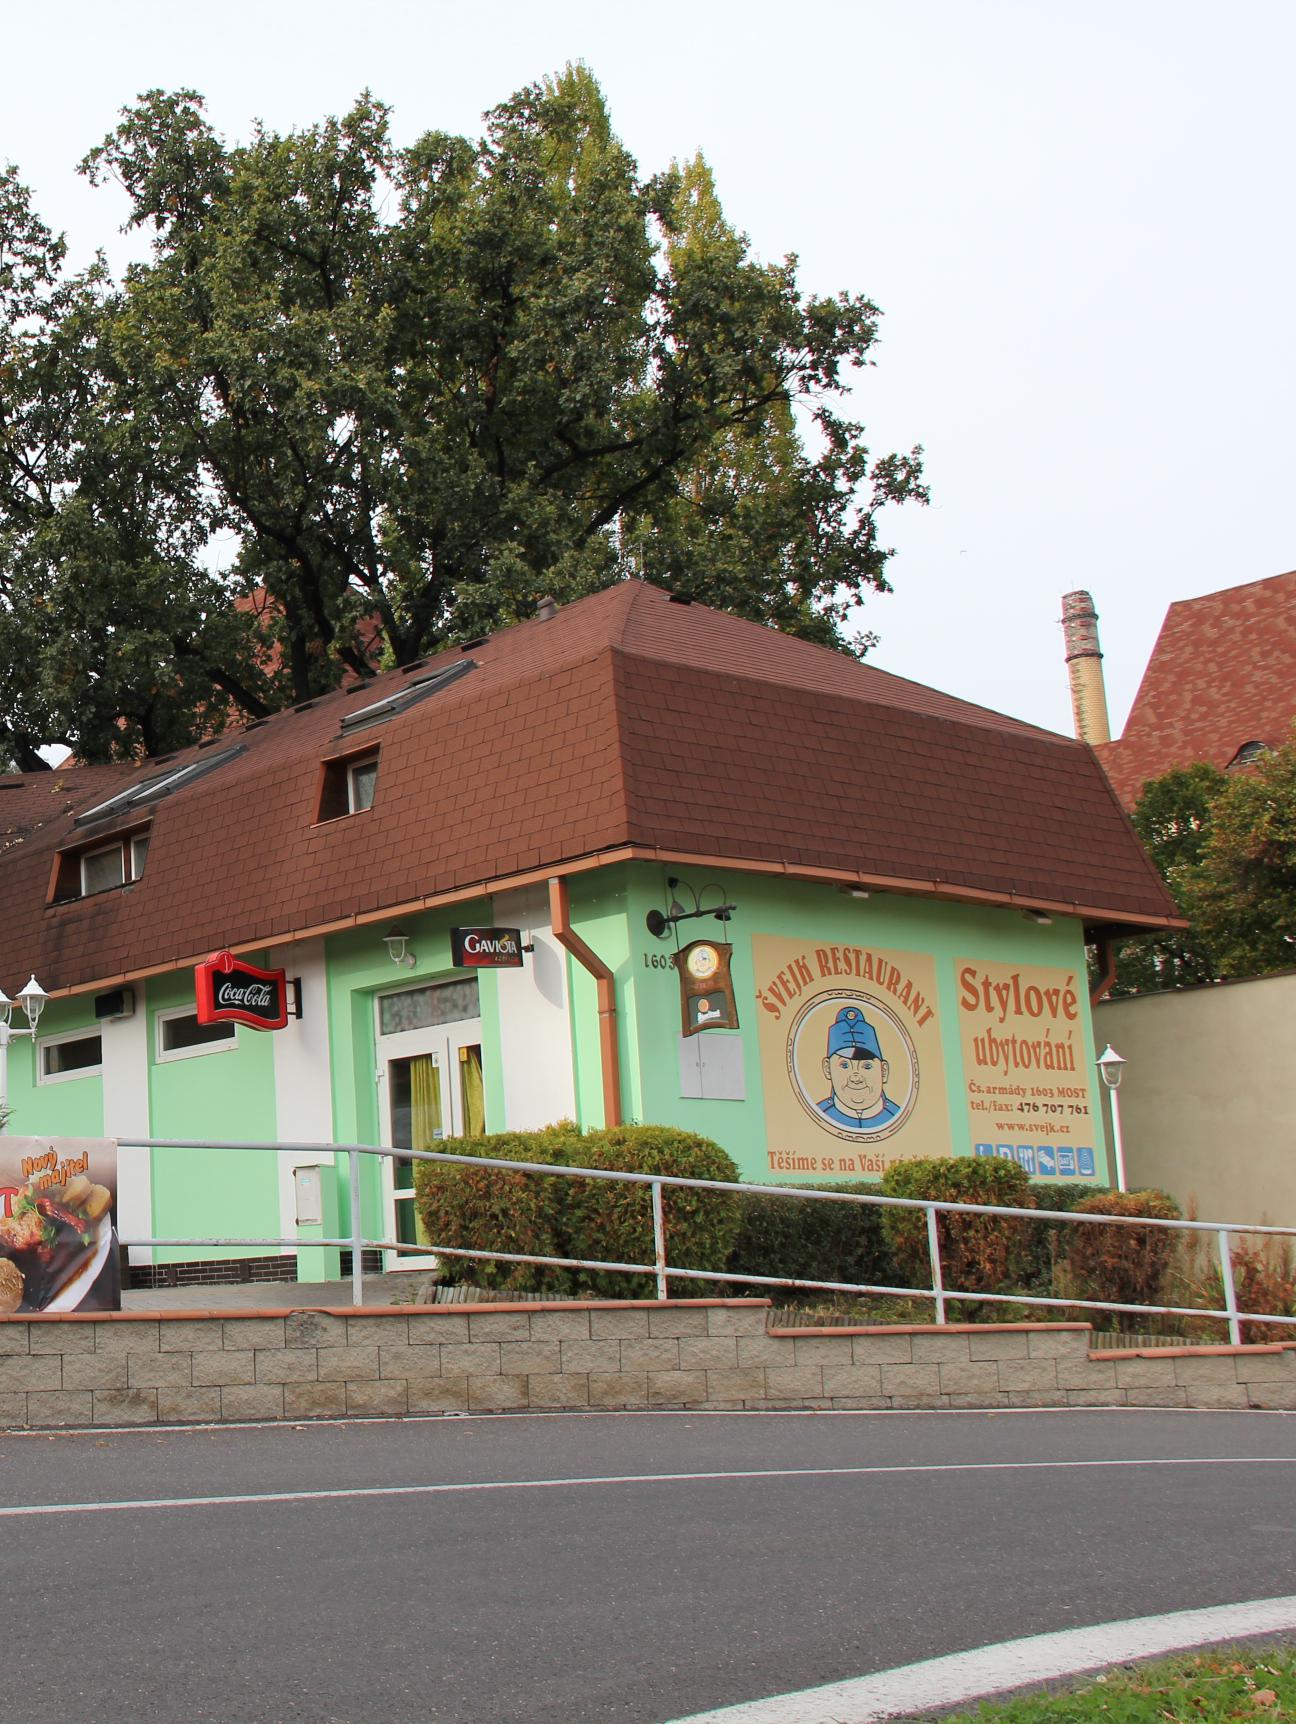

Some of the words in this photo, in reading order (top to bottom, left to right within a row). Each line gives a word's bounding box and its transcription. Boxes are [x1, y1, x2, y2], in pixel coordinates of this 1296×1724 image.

[464, 934, 518, 954] GAVIOTA
[218, 982, 273, 1007] Coca-Cola
[756, 955, 814, 1021] ŠVEJK
[815, 946, 935, 1028] RESTAURANT
[960, 967, 1078, 1024] Stylové
[973, 1026, 1076, 1077] ubytování
[1030, 1087, 1054, 1098] 1603
[1057, 1087, 1087, 1099] MOST
[970, 1100, 1013, 1113] tel./fax:
[1017, 1102, 1039, 1113] 476
[1042, 1103, 1064, 1115] 707
[1067, 1105, 1089, 1116] 761
[995, 1122, 1070, 1136] www.svejk.cz
[21, 1145, 58, 1178] Nový
[39, 1150, 89, 1191] majitel
[767, 1150, 817, 1171] Těšíme
[821, 1158, 835, 1172] se
[839, 1158, 856, 1172] na
[858, 1153, 886, 1173] Vaší
